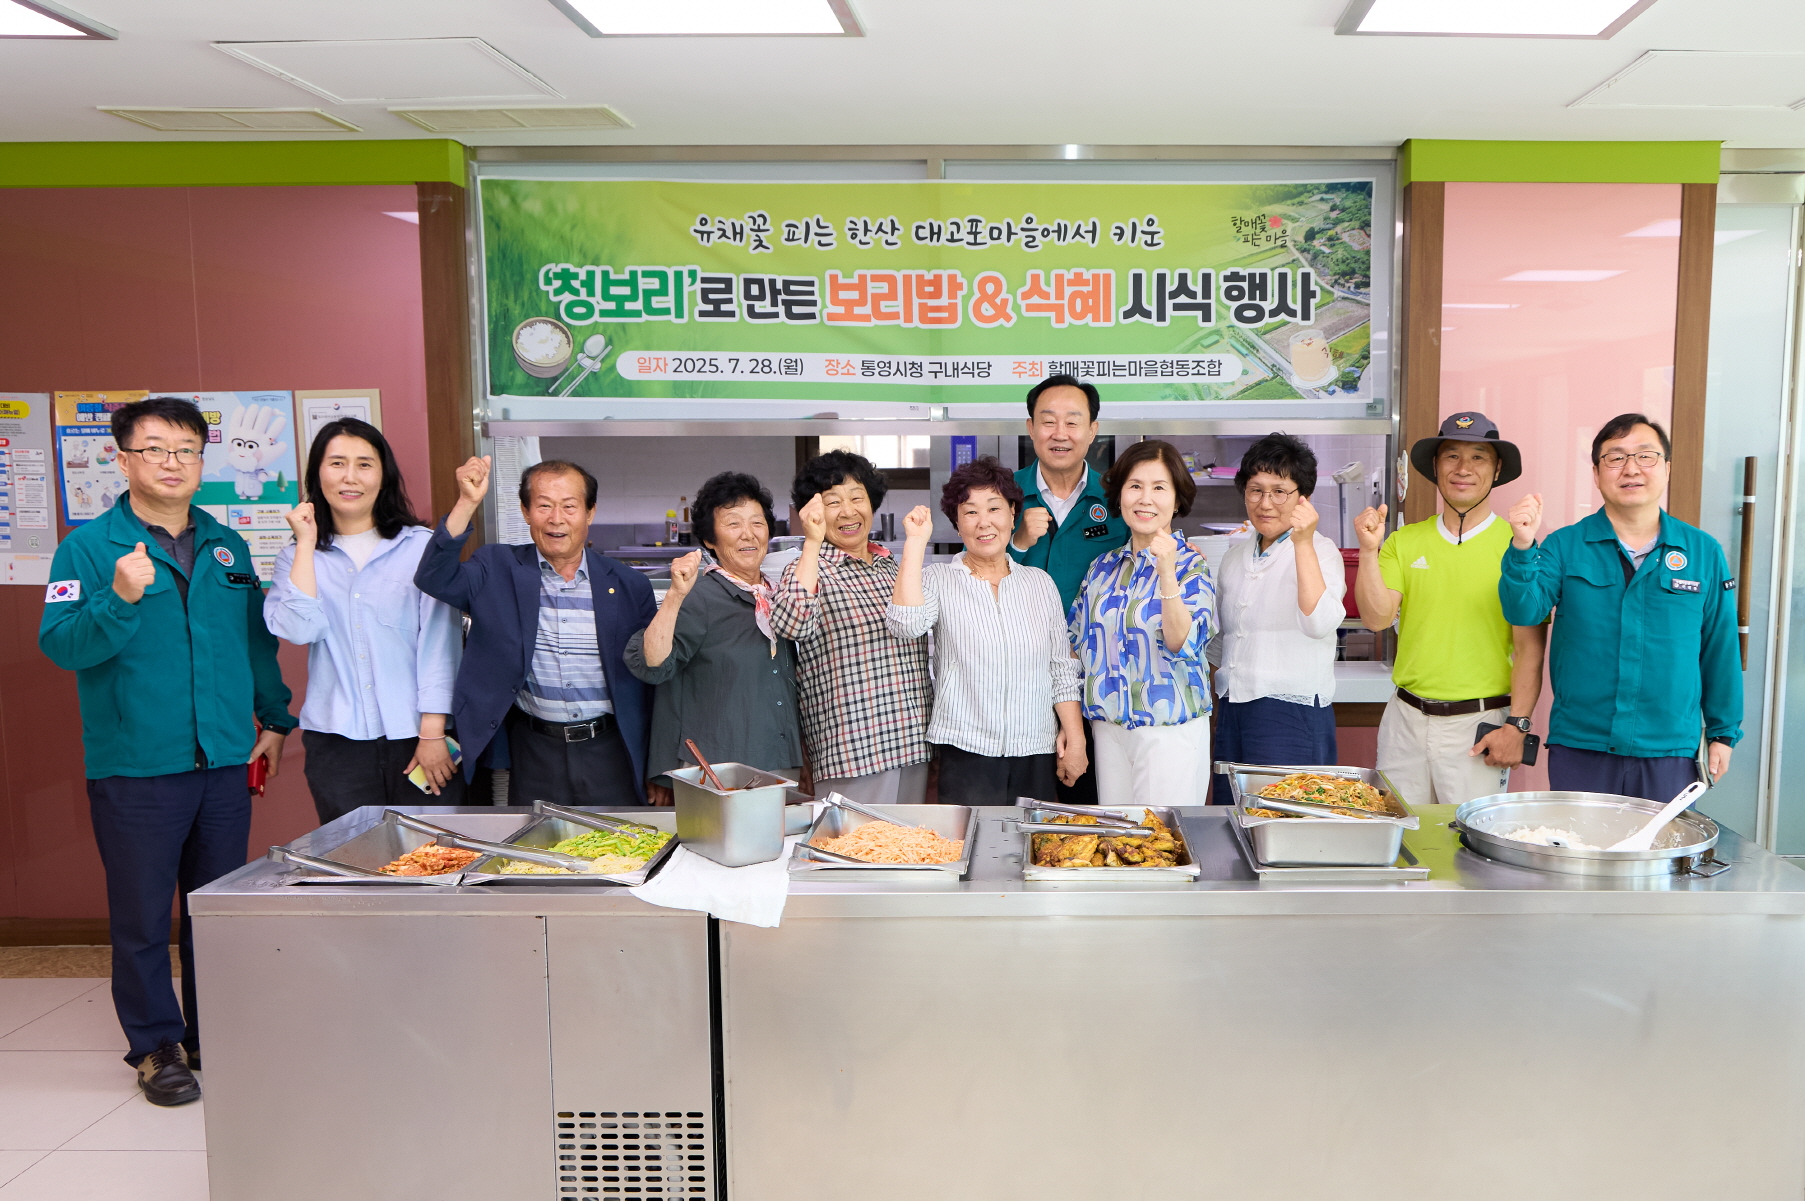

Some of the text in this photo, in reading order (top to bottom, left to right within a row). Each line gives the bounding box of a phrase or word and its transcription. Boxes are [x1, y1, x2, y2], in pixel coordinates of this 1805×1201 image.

[692, 213, 1163, 251] 유채꽃 피는 한산 대고포마을에서 키운
[1231, 213, 1267, 233] 할매꽃
[1265, 229, 1290, 248] 마을
[743, 277, 817, 320] 만든
[828, 272, 963, 325] 보리밥
[971, 274, 1013, 325] &
[1020, 271, 1112, 325] 식혜
[1121, 270, 1212, 324] 시식
[1222, 270, 1318, 325] 행사
[636, 356, 805, 376] 일자 2025. 7. 28.(월)
[824, 358, 992, 379] 장소 통영시청 구내식당
[1011, 358, 1223, 379] 주최 할매꽃피는마을협동조합
